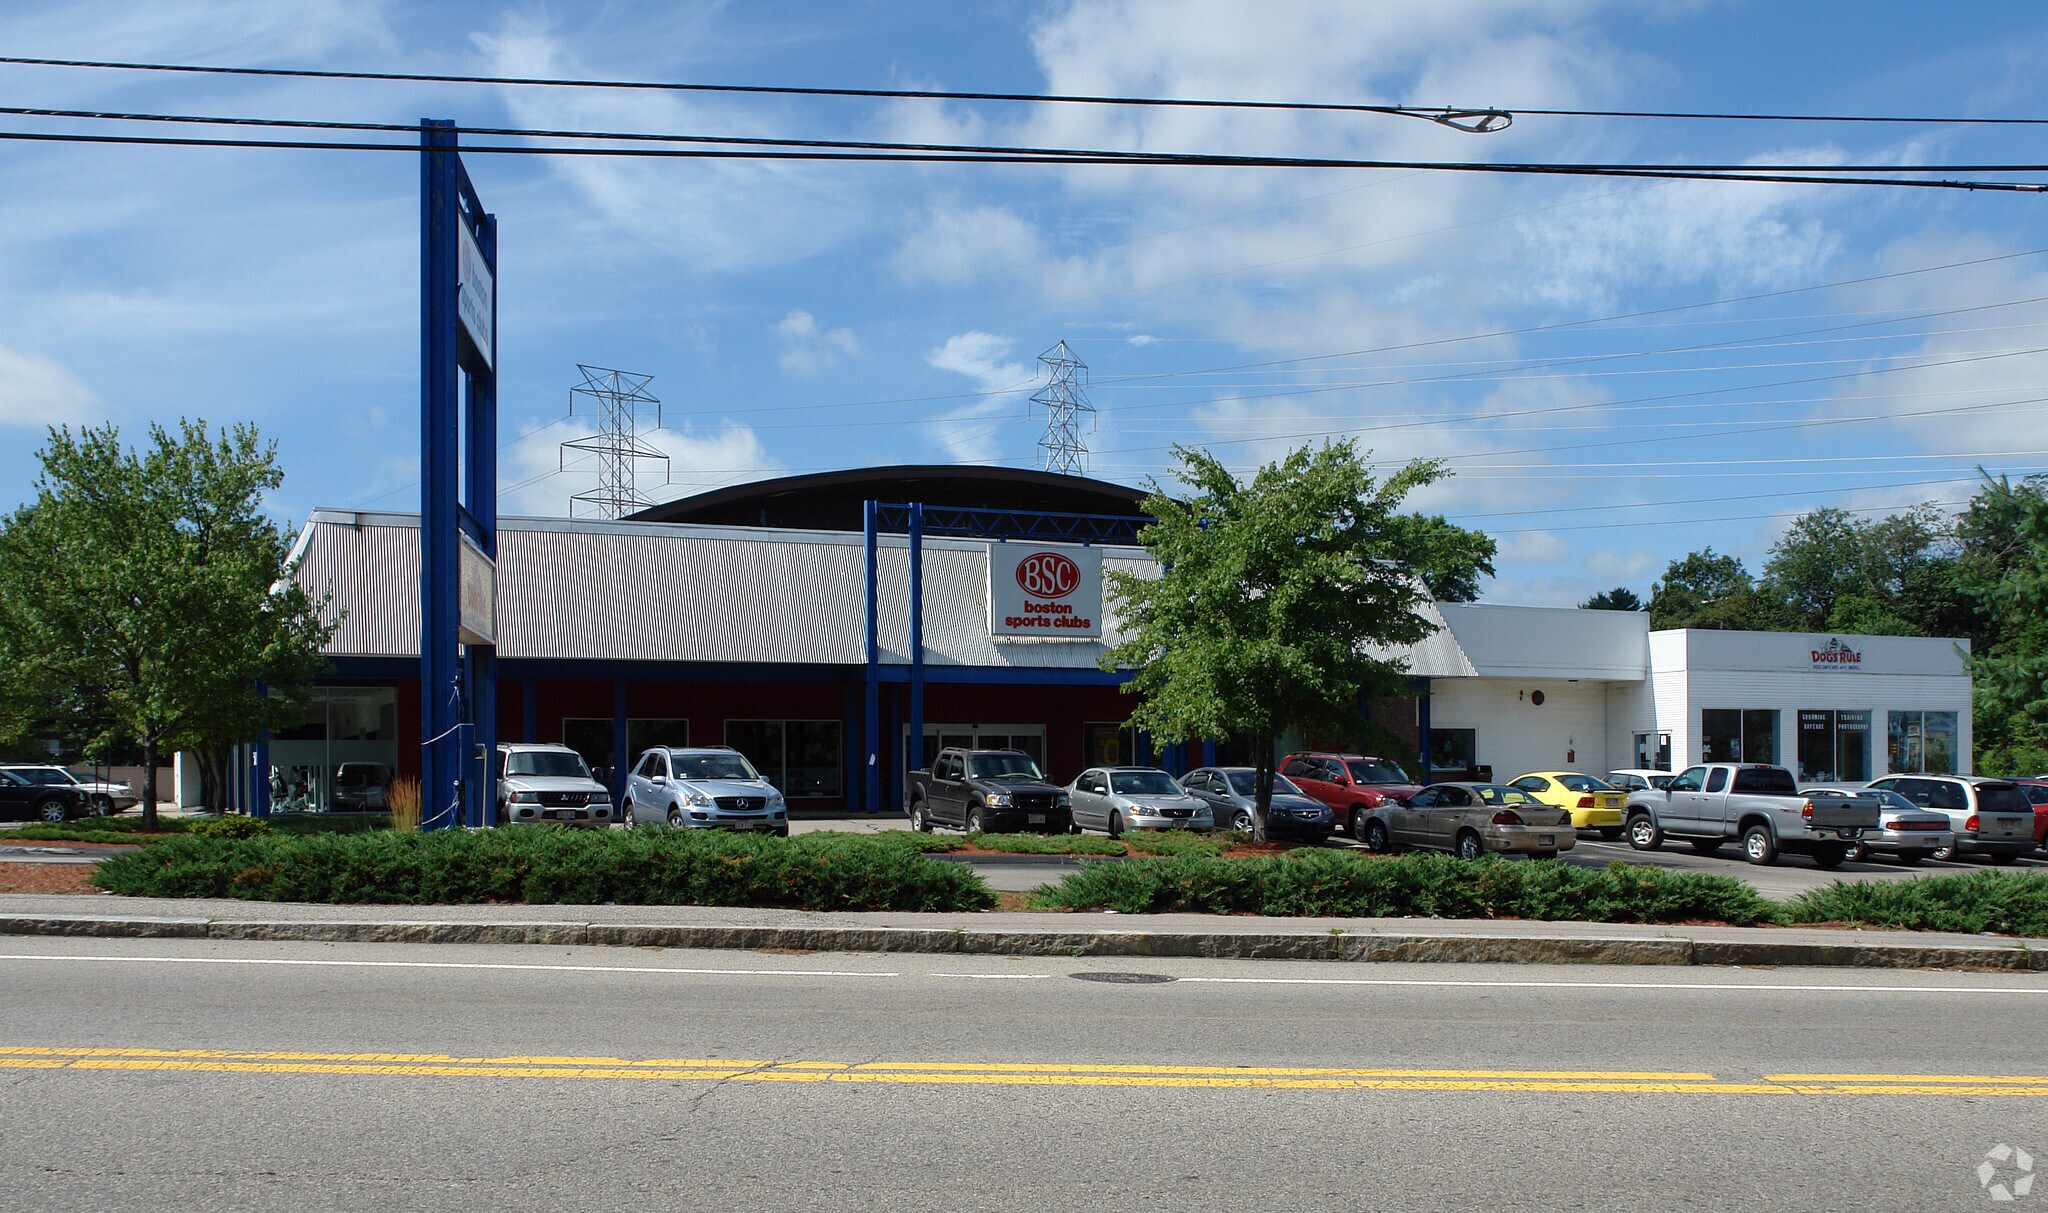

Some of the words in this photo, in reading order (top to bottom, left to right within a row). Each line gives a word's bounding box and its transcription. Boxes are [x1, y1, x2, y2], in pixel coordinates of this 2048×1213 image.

[1024, 557, 1070, 594] BSC
[1024, 600, 1072, 614] boston
[1005, 615, 1051, 628] sports
[1053, 616, 1091, 628] clubs
